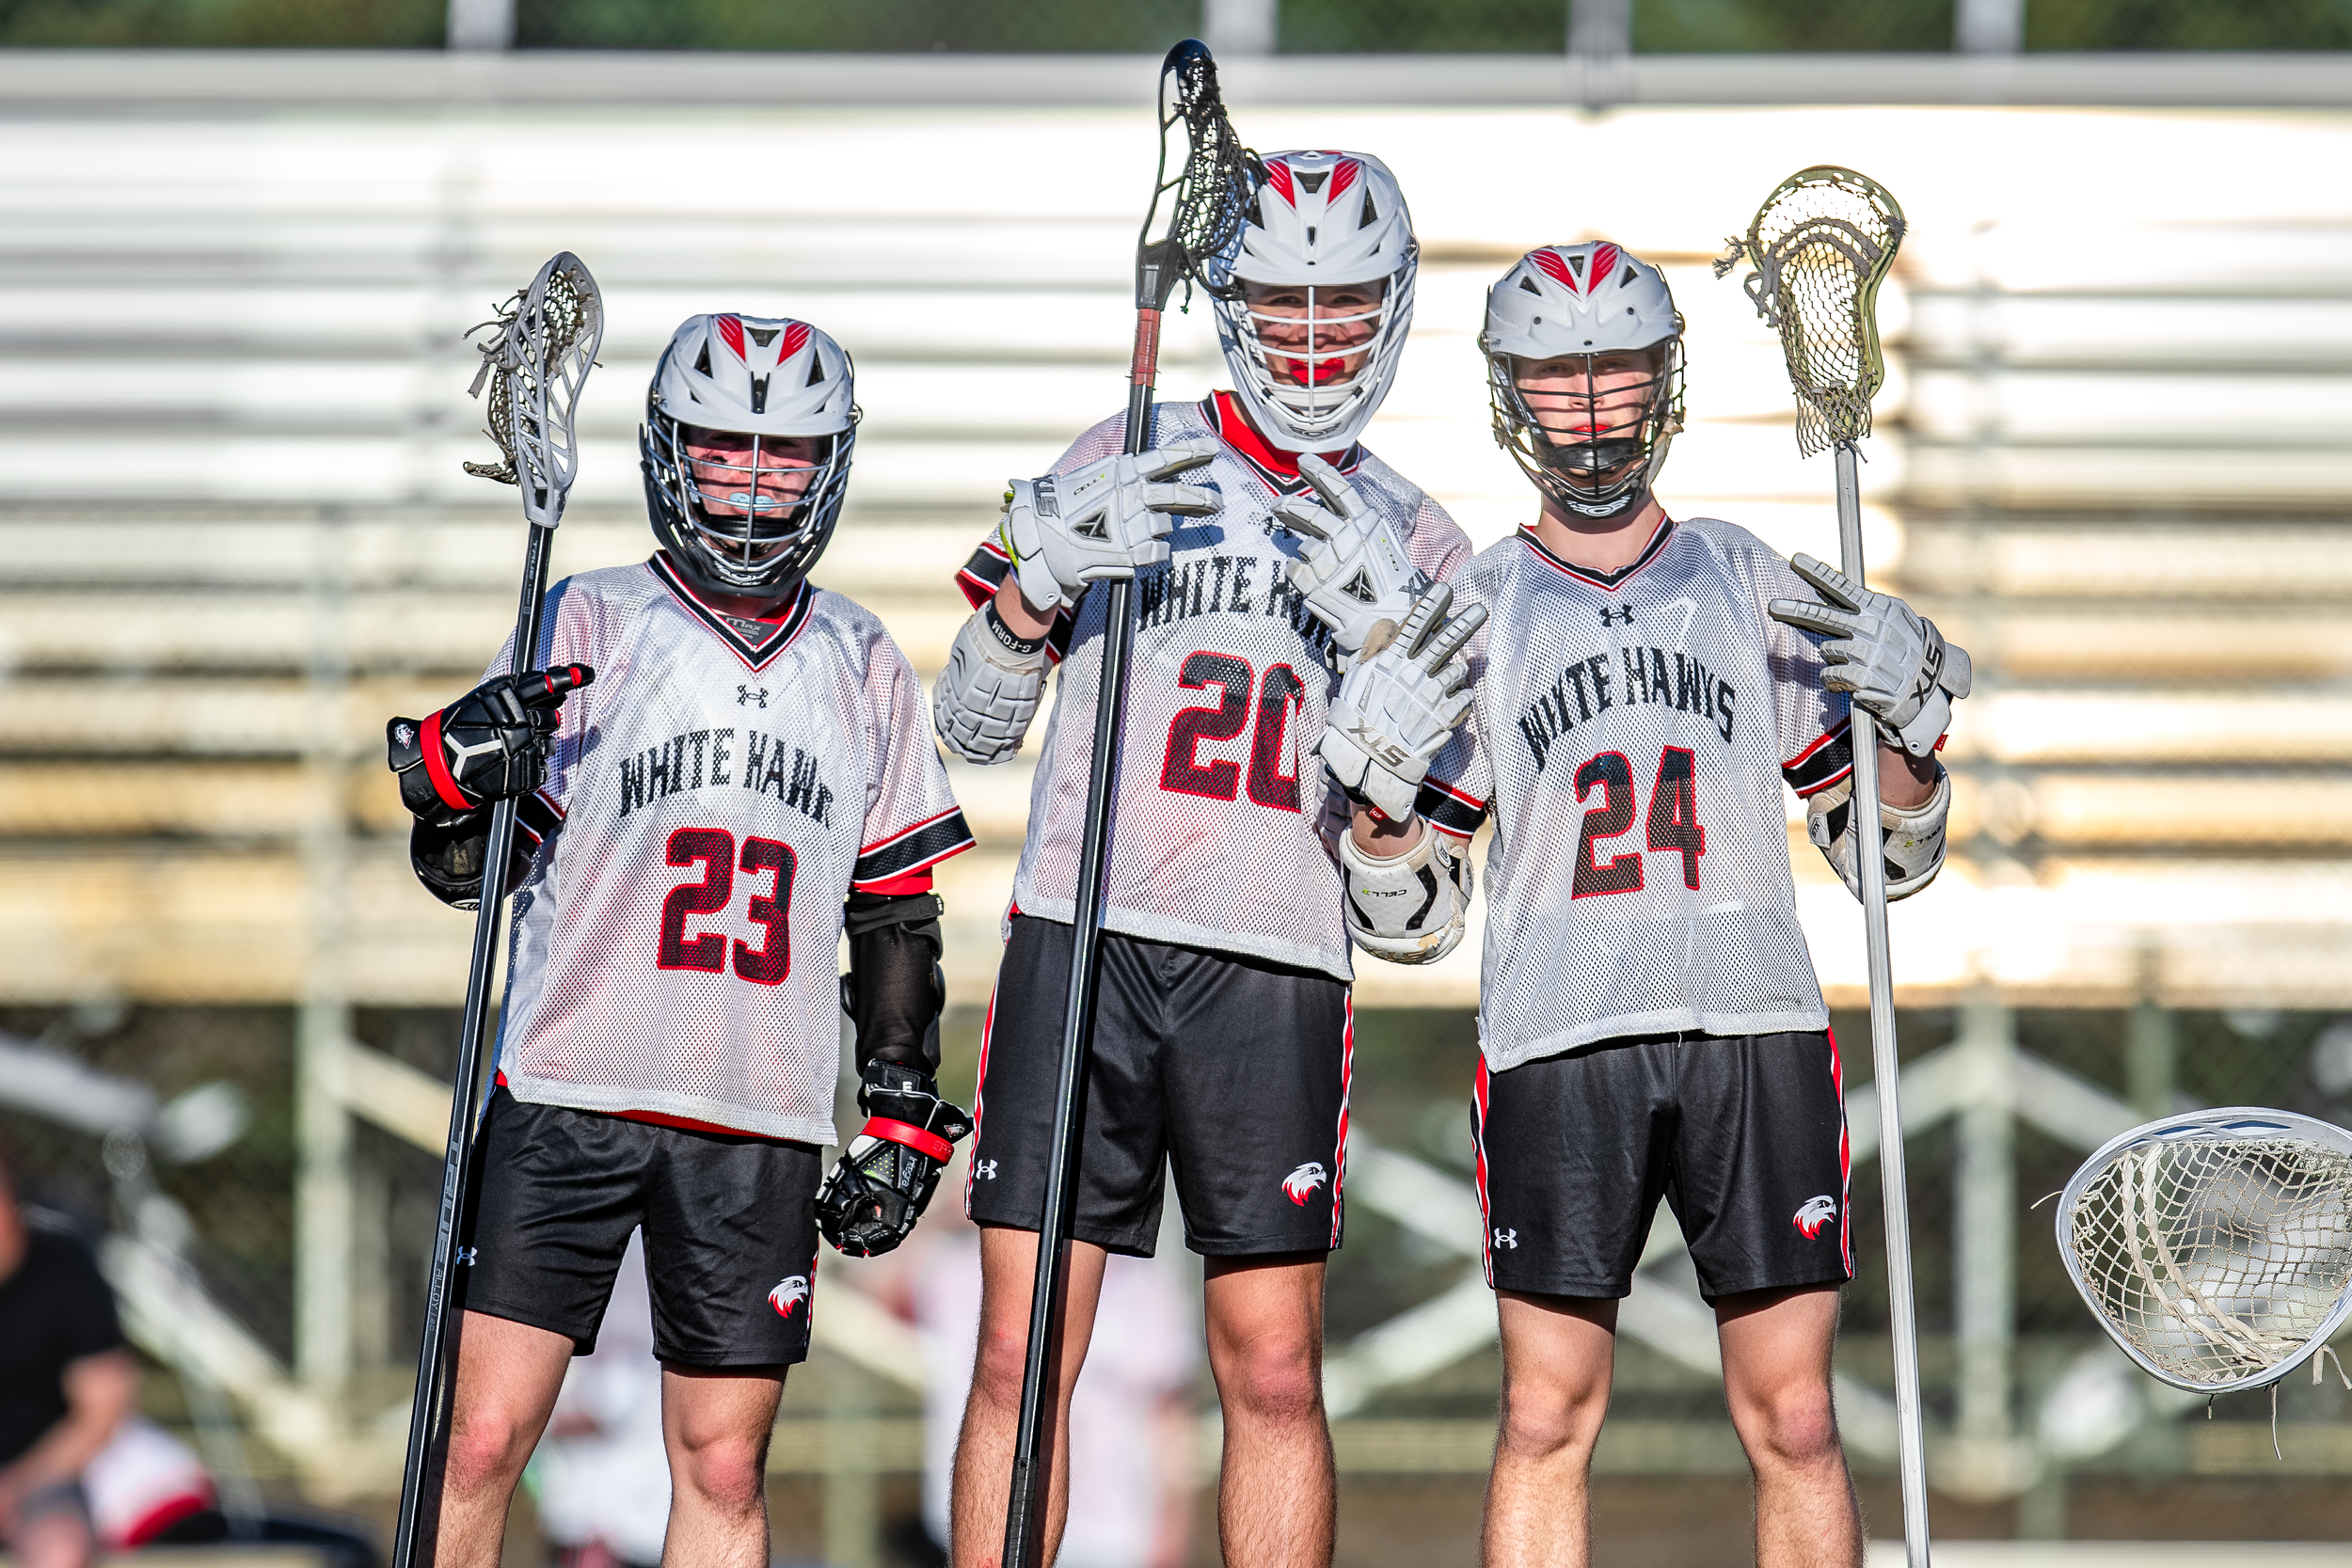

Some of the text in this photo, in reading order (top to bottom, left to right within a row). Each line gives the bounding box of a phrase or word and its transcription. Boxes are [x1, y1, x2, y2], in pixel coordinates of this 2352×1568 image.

[1398, 568, 1435, 608] TX
[992, 620, 1032, 653] G-FORM
[1909, 640, 1943, 708] STX
[1159, 650, 1305, 814] 20
[1346, 717, 1411, 767] STX
[619, 728, 734, 818] WHITE
[1571, 745, 1706, 900] 24
[657, 827, 798, 986] 23
[437, 1131, 462, 1264] TRUE
[901, 1155, 917, 1187] Integra
[431, 1268, 443, 1310] ALLOY
